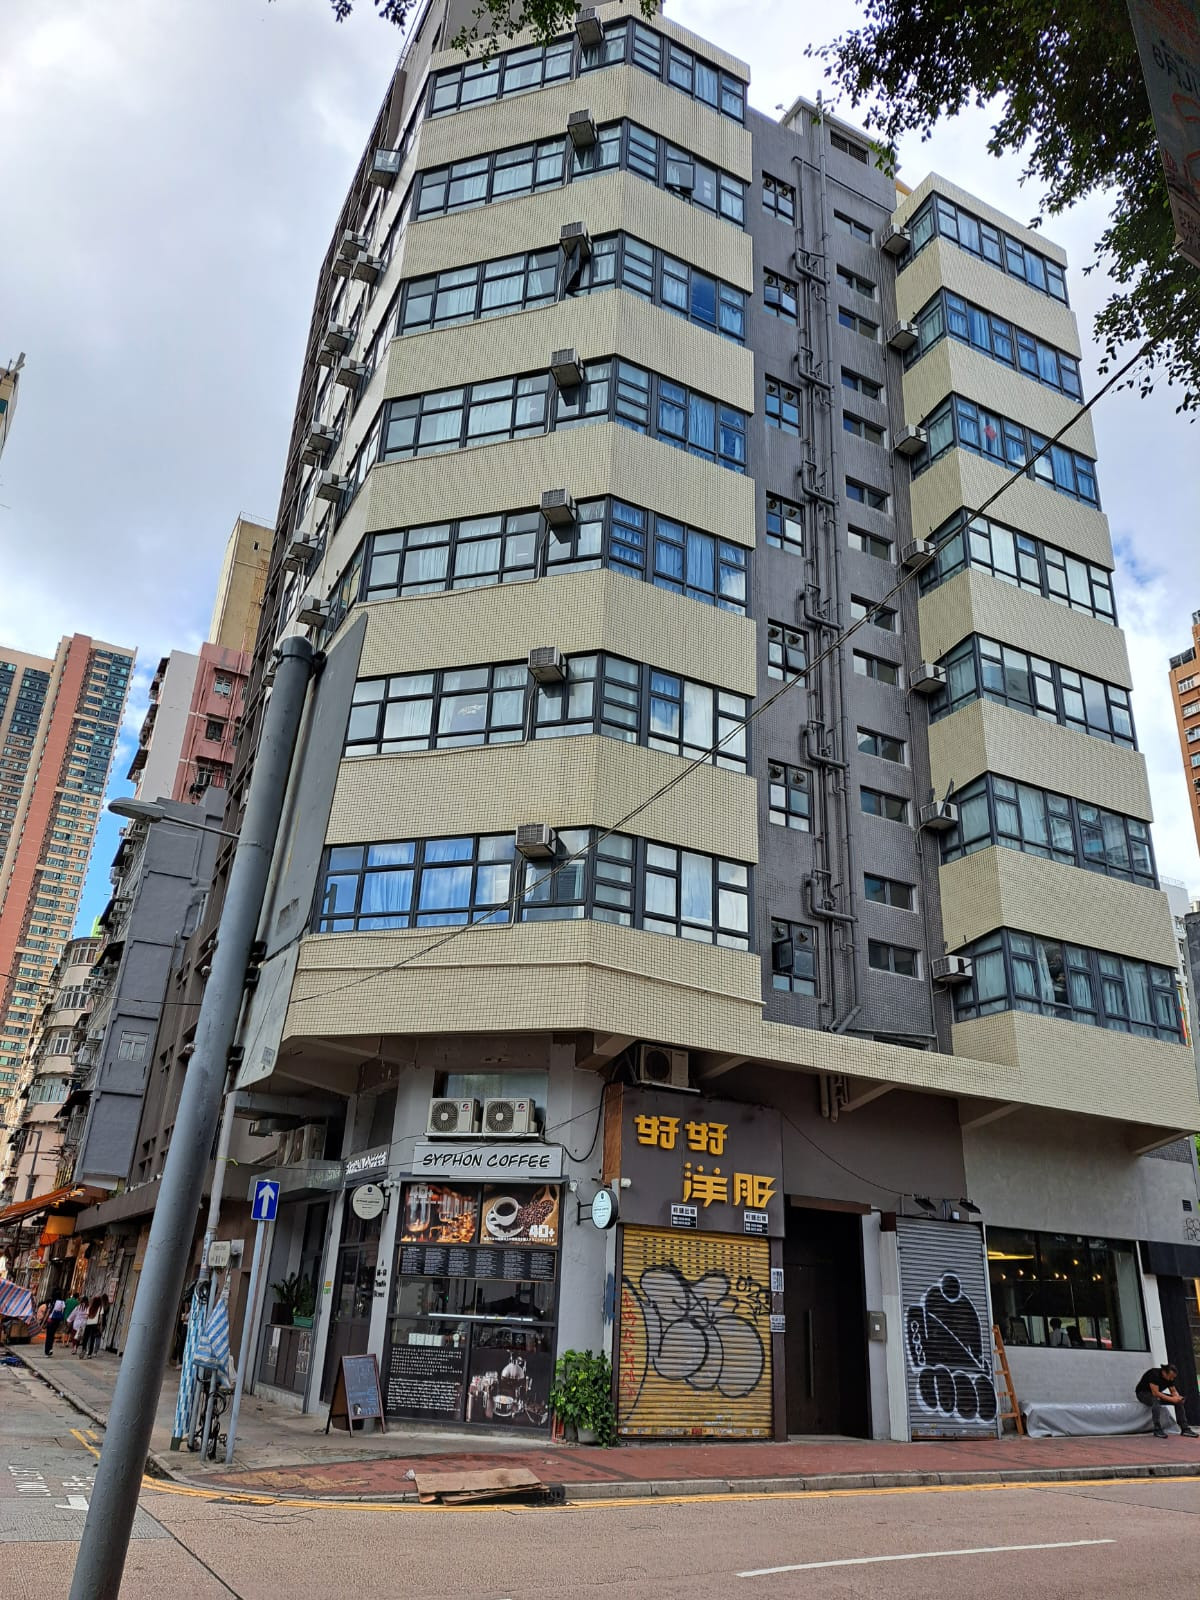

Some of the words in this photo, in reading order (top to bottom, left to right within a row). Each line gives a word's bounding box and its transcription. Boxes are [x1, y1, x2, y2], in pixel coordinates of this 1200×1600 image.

[634, 1115, 729, 1155] 好好
[422, 1153, 482, 1168] SYPHON
[486, 1154, 551, 1168] COFFEE
[682, 1162, 777, 1209] 洋服
[15, 1480, 52, 1497] LOOK
